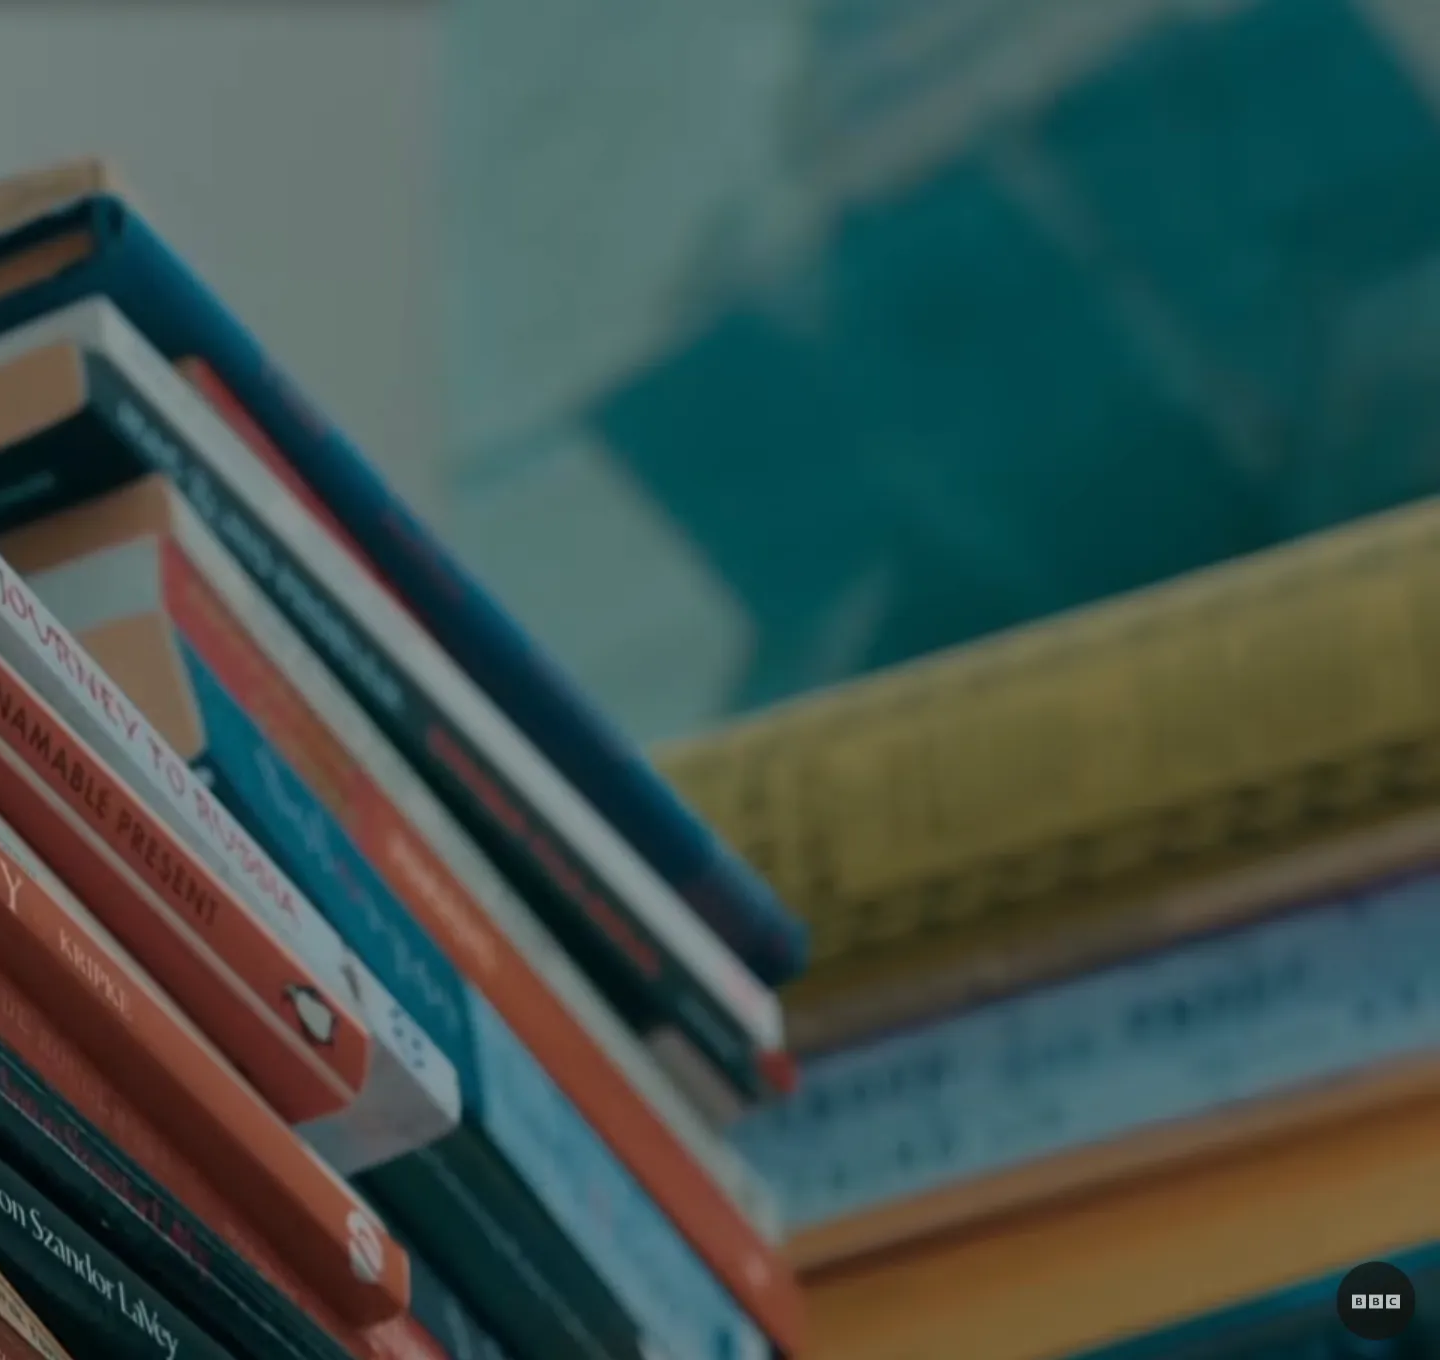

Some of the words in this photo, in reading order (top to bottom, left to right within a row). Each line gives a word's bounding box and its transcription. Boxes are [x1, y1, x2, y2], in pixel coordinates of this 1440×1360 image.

[148, 736, 187, 797] TO
[116, 807, 220, 928] PRESENT
[58, 927, 133, 1022] KRIPKE
[28, 1207, 116, 1301] Szandor
[117, 1280, 179, 1360] LaVey
